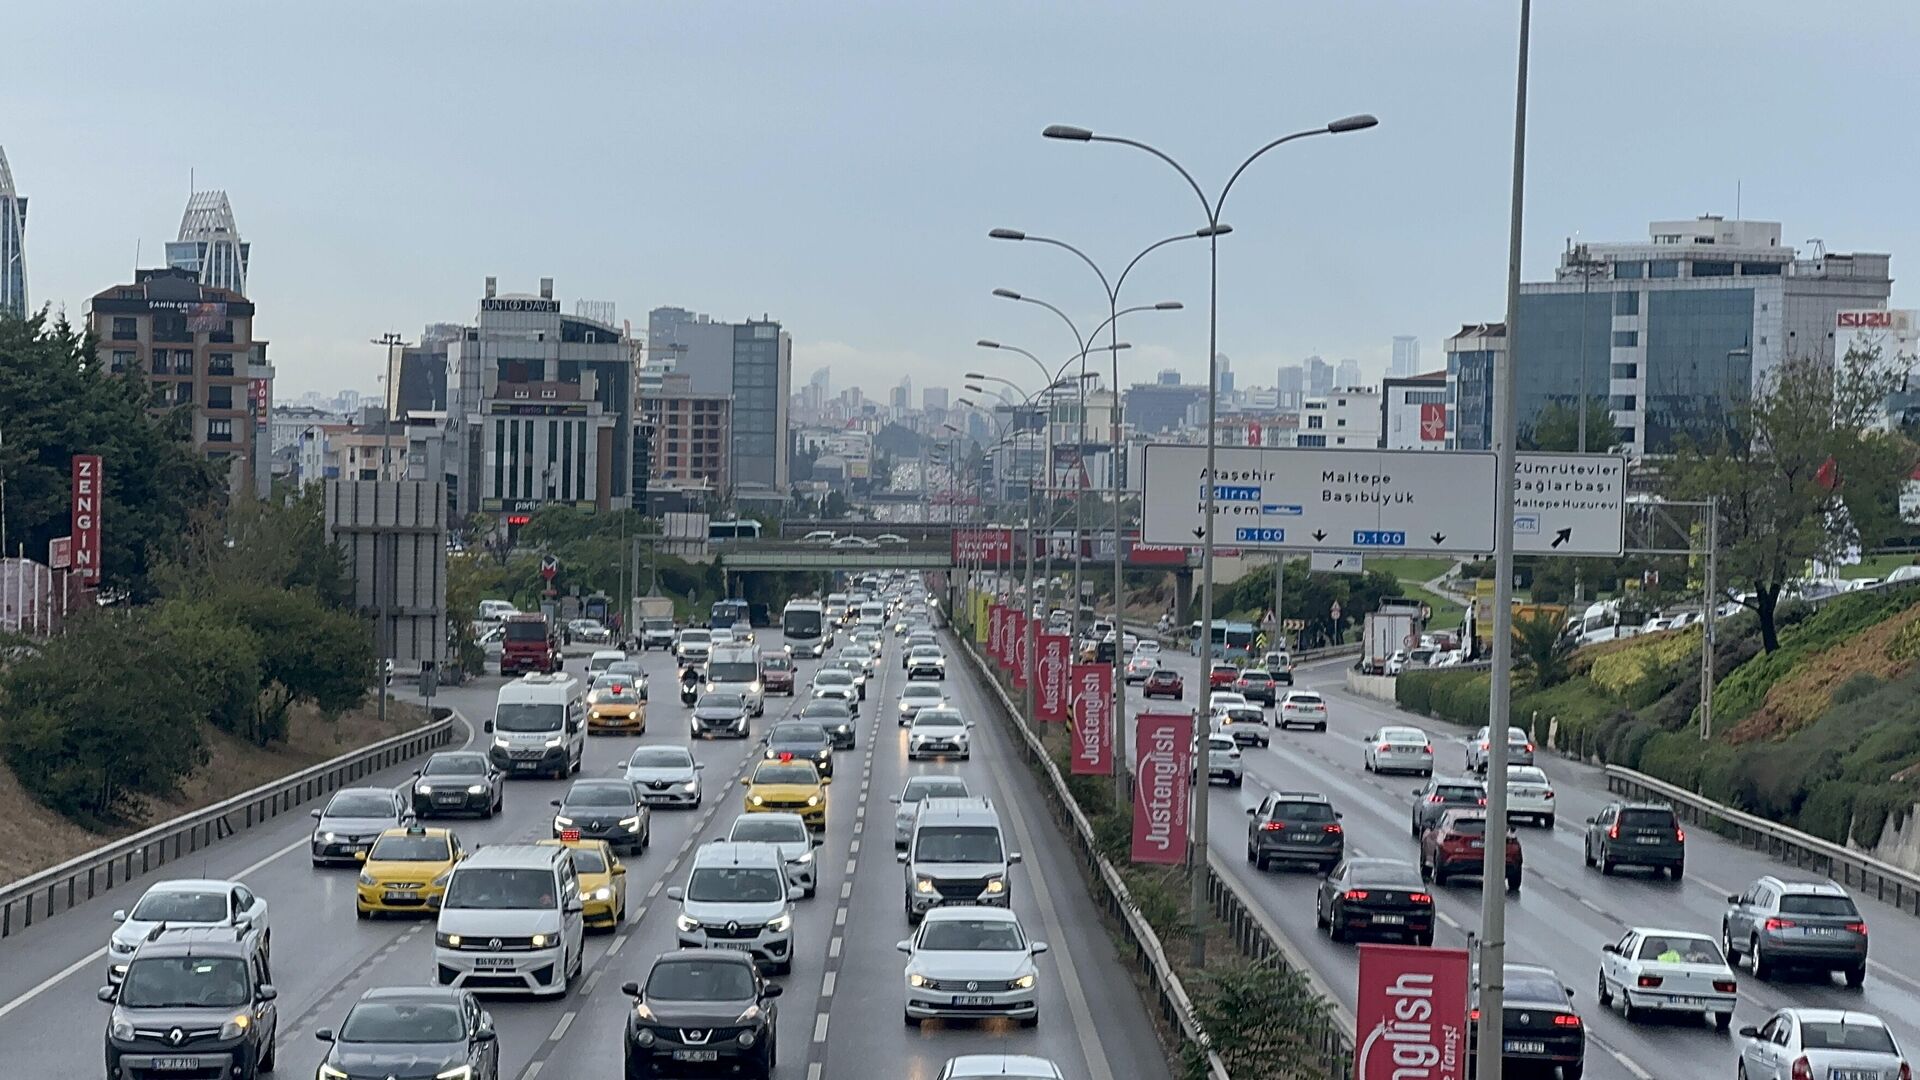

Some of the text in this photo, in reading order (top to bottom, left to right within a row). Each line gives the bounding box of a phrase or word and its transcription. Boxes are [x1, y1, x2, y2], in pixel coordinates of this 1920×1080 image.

[525, 301, 559, 311] DAVET
[1837, 312, 1892, 328] ISUZU
[1322, 471, 1391, 486] Maltepe
[1198, 503, 1259, 515] Harem
[1515, 499, 1618, 510] Maltepe Huzurevi
[1238, 529, 1282, 540] D.100
[1357, 532, 1401, 543] D.100
[1081, 672, 1103, 766] Justenglish
[1146, 726, 1178, 850] Justenglish
